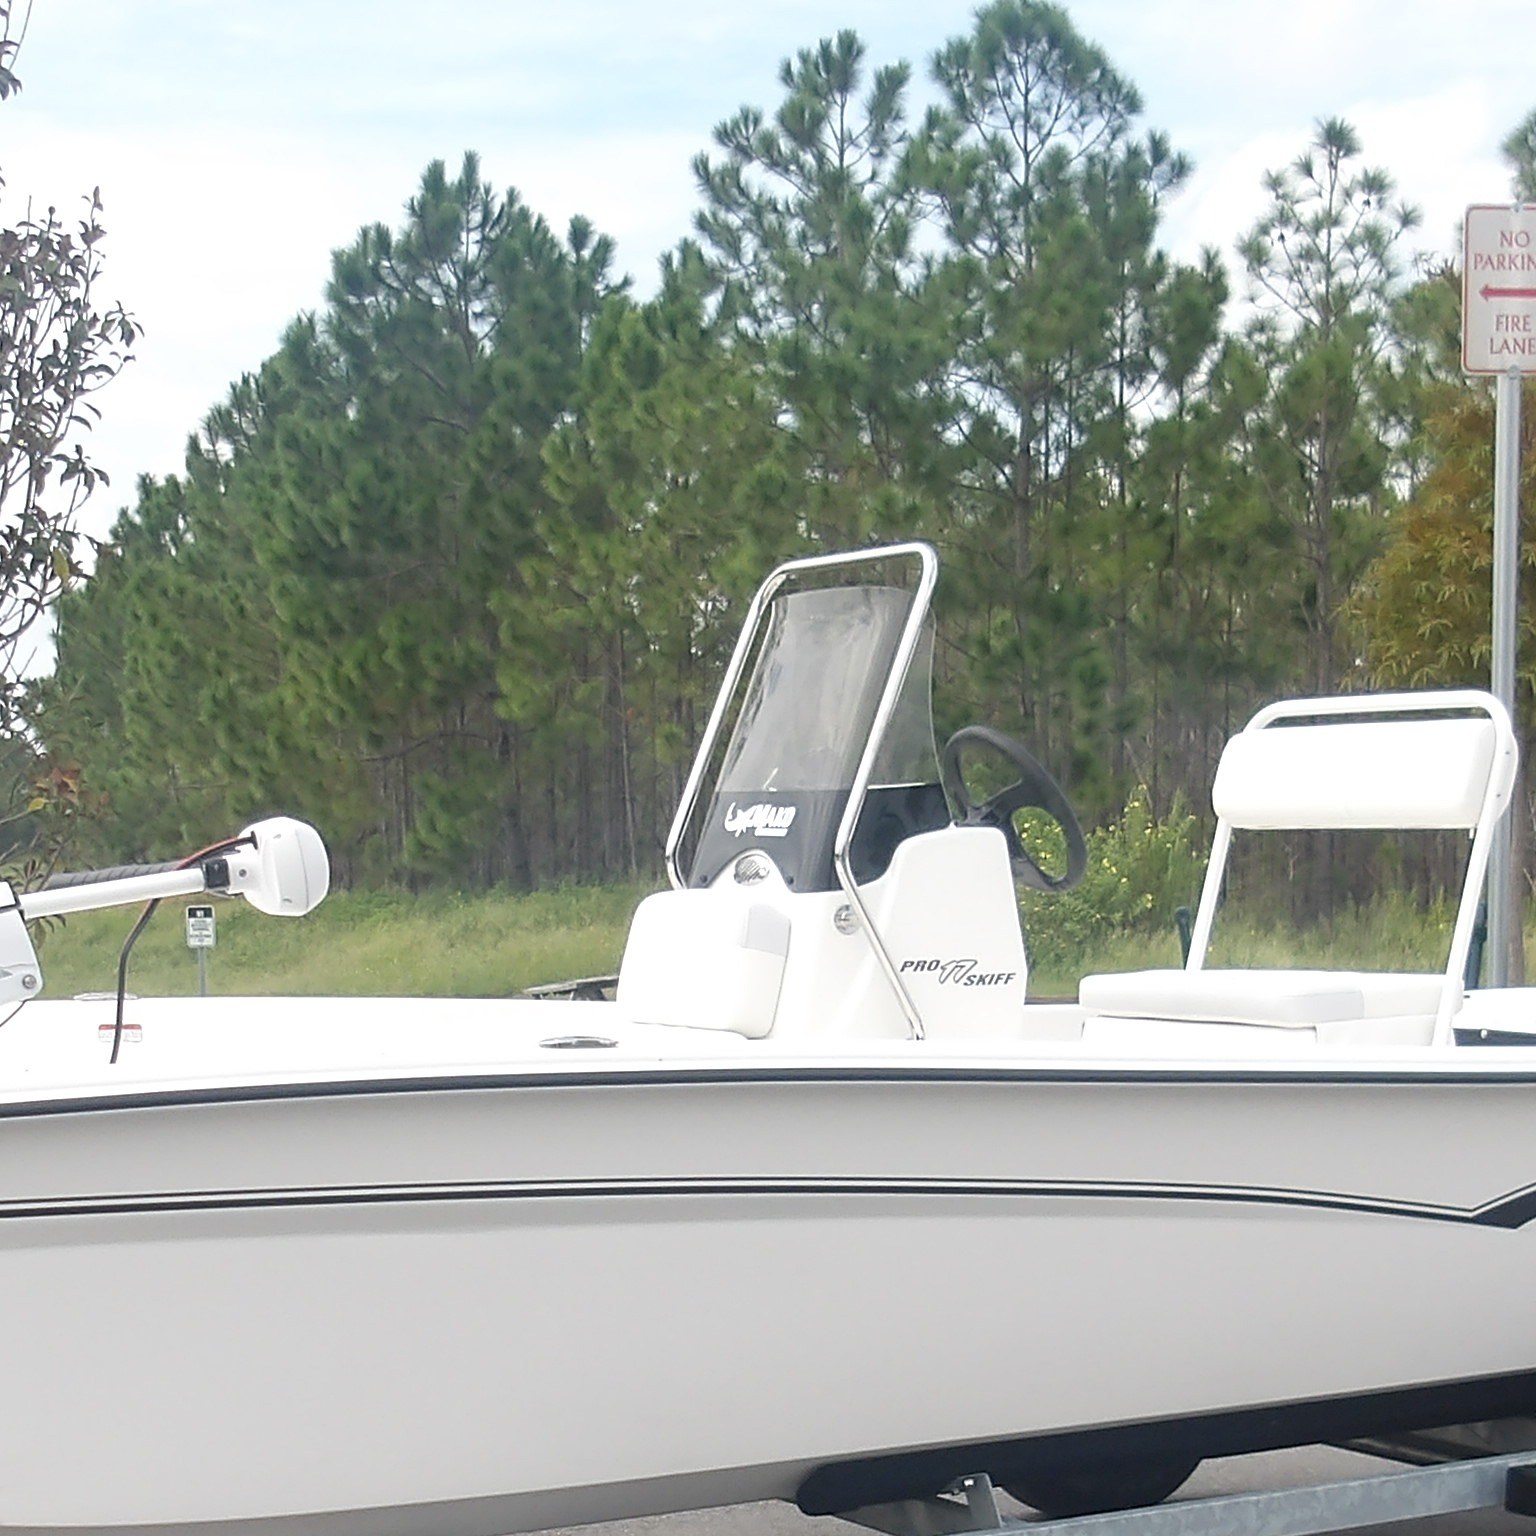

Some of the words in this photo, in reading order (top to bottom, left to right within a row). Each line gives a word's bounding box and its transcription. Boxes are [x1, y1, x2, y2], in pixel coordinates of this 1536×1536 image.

[1499, 230, 1531, 248] NO
[1495, 314, 1532, 333] FIRE
[1489, 337, 1536, 355] LANE
[900, 959, 941, 973] PRO
[963, 972, 1017, 986] SKIFF
